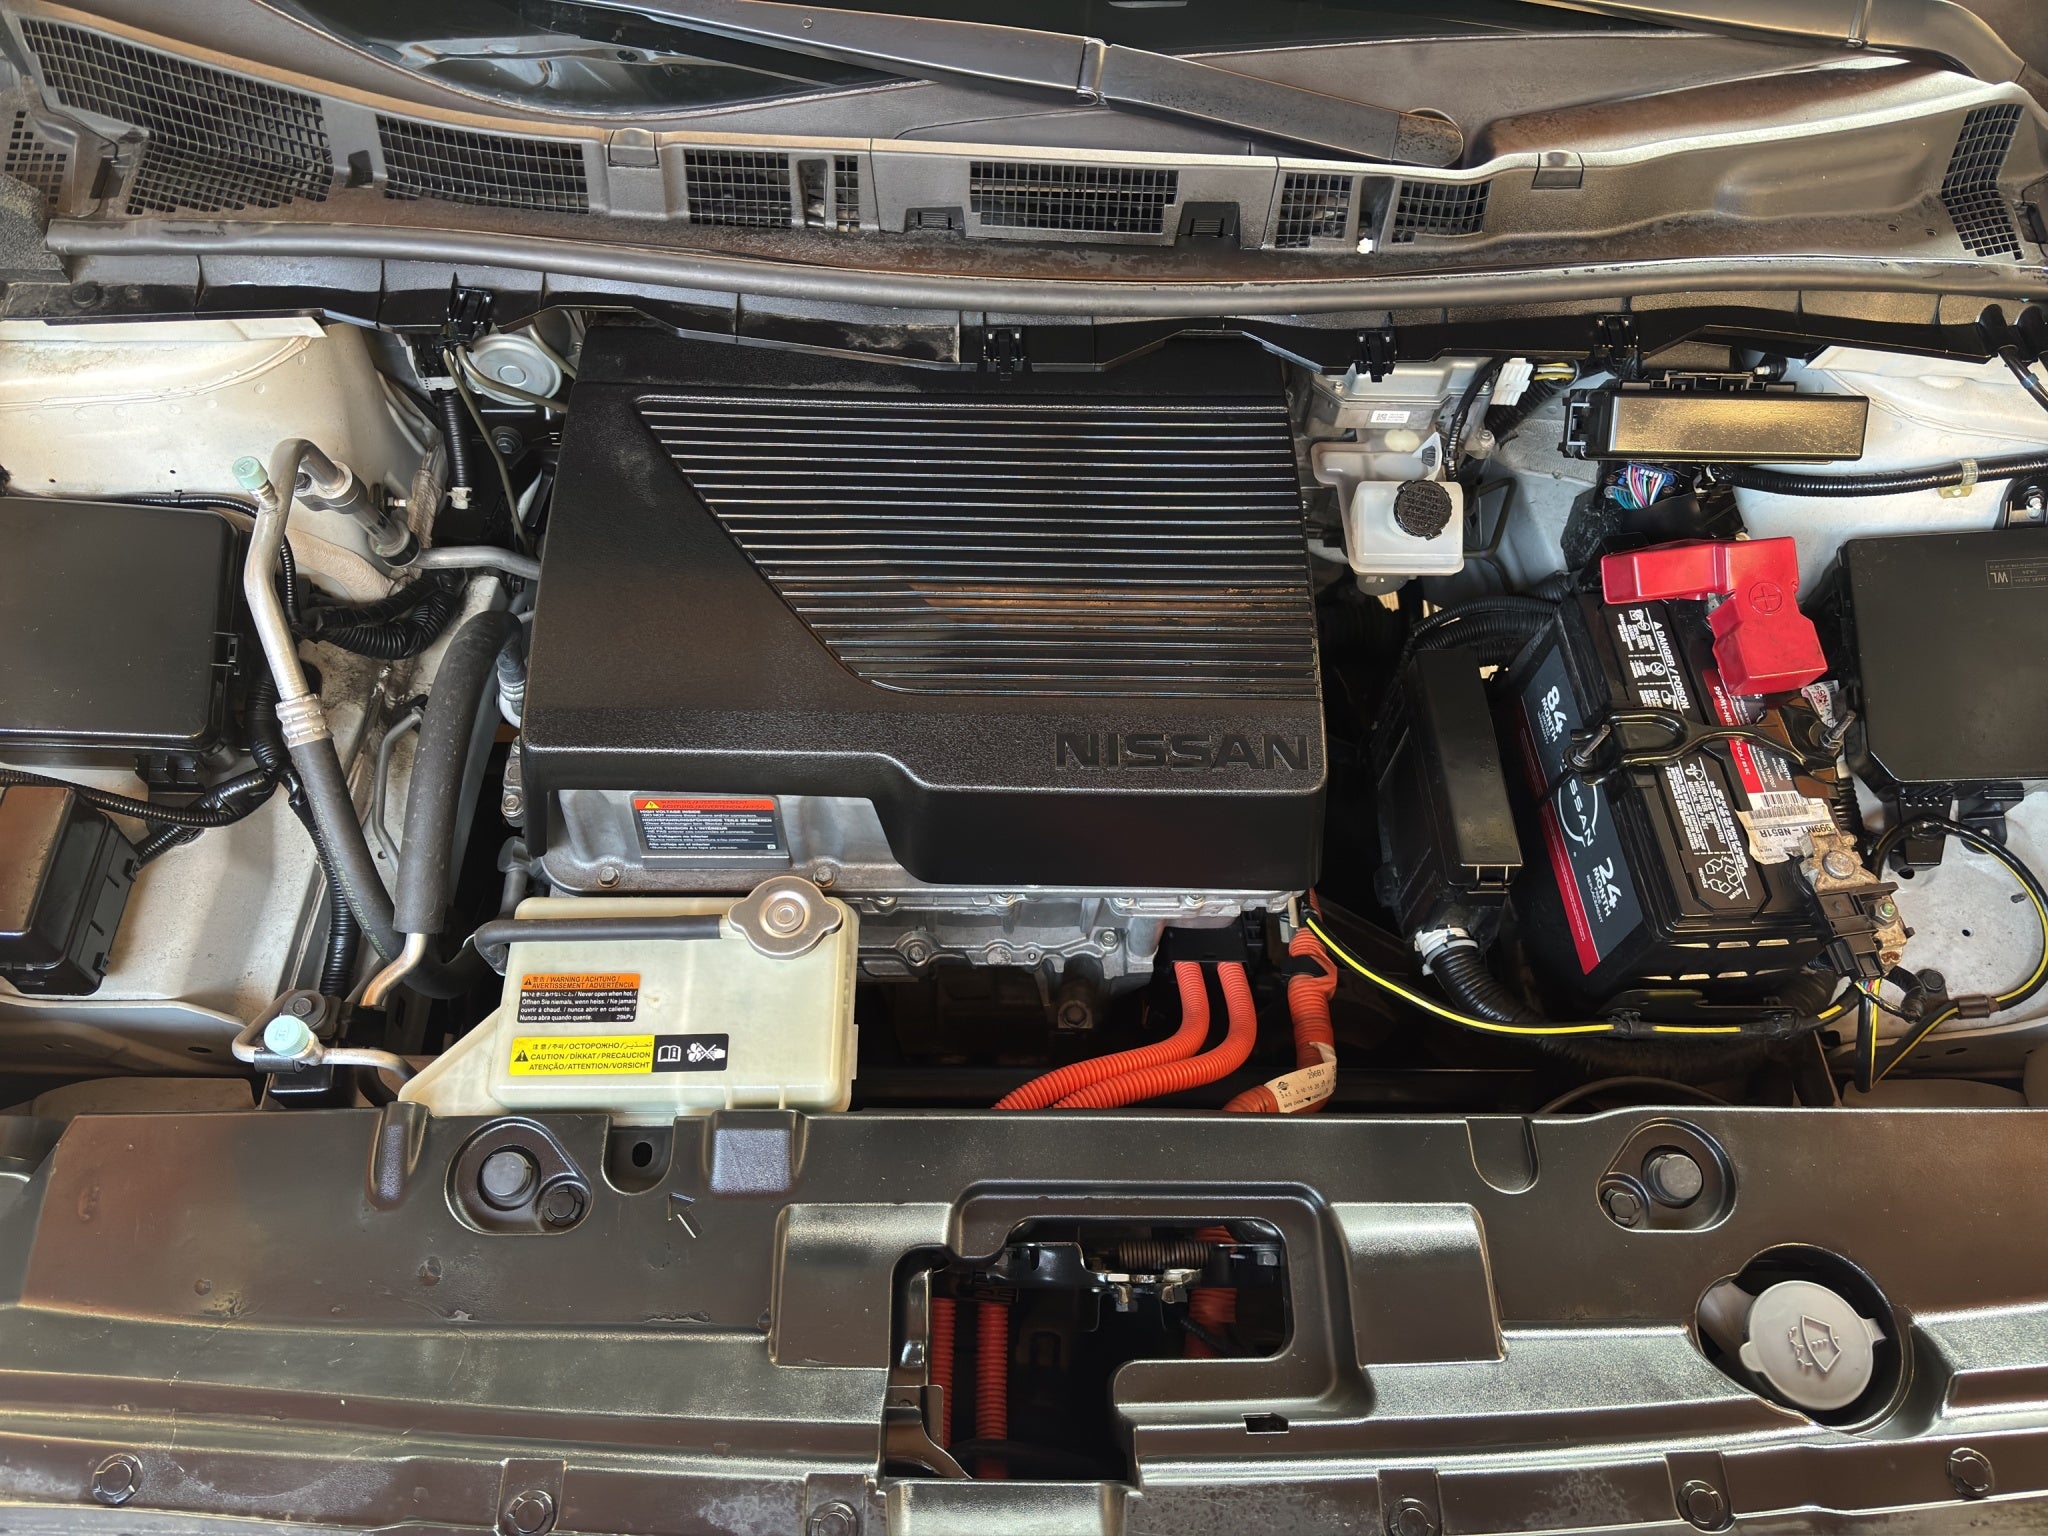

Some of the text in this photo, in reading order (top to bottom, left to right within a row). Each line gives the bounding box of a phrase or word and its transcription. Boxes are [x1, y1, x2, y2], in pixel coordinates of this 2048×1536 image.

[1656, 630, 1675, 667] DANGER
[1672, 675, 1690, 709] POISON
[1541, 697, 1558, 742] MONTH
[1547, 686, 1567, 734] 84
[1713, 685, 1733, 727] 999M1-NB5
[1056, 734, 1310, 770] NISSAN
[1778, 756, 1791, 781] MONTH
[1694, 802, 1704, 816] HELP
[1699, 816, 1709, 830] FAST
[1704, 796, 1714, 811] EYES
[1593, 867, 1611, 916] MONTH
[1599, 857, 1622, 908] 24
[602, 1051, 650, 1059] PRECAUCION
